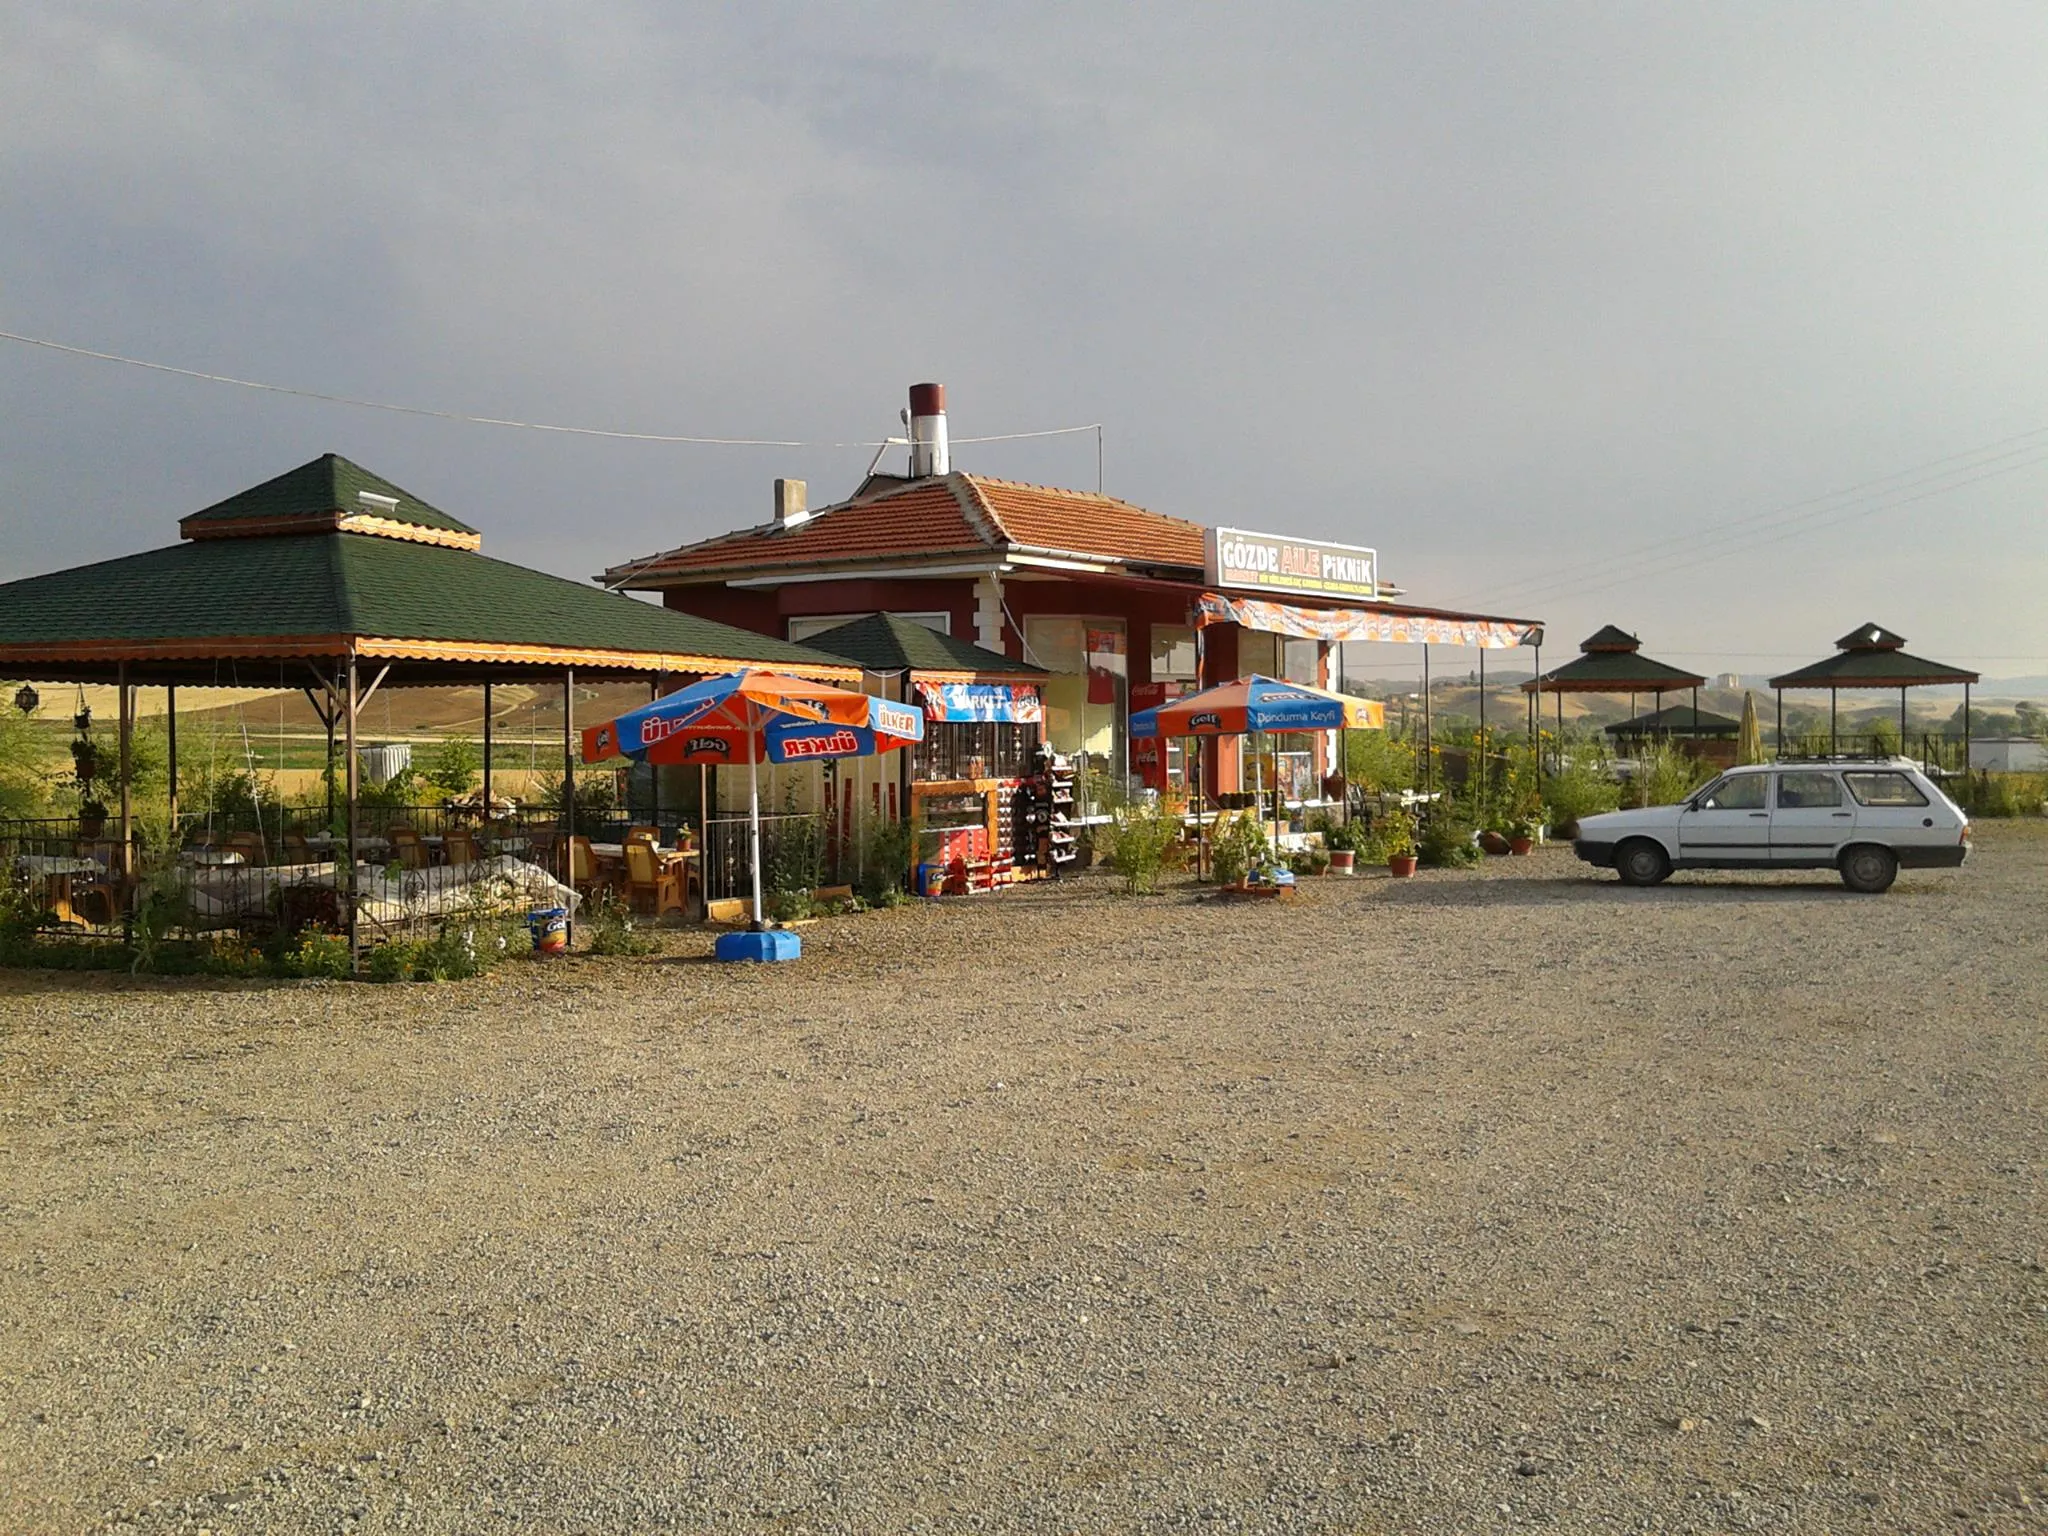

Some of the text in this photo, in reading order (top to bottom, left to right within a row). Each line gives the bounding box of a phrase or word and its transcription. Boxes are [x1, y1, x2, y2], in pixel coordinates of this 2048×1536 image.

[1222, 536, 1279, 573] GÖZDE
[878, 704, 916, 736] ÜLKER
[1190, 713, 1218, 727] Golf
[1257, 711, 1336, 724] Dondurma Keyfi
[547, 920, 566, 932] Gol
